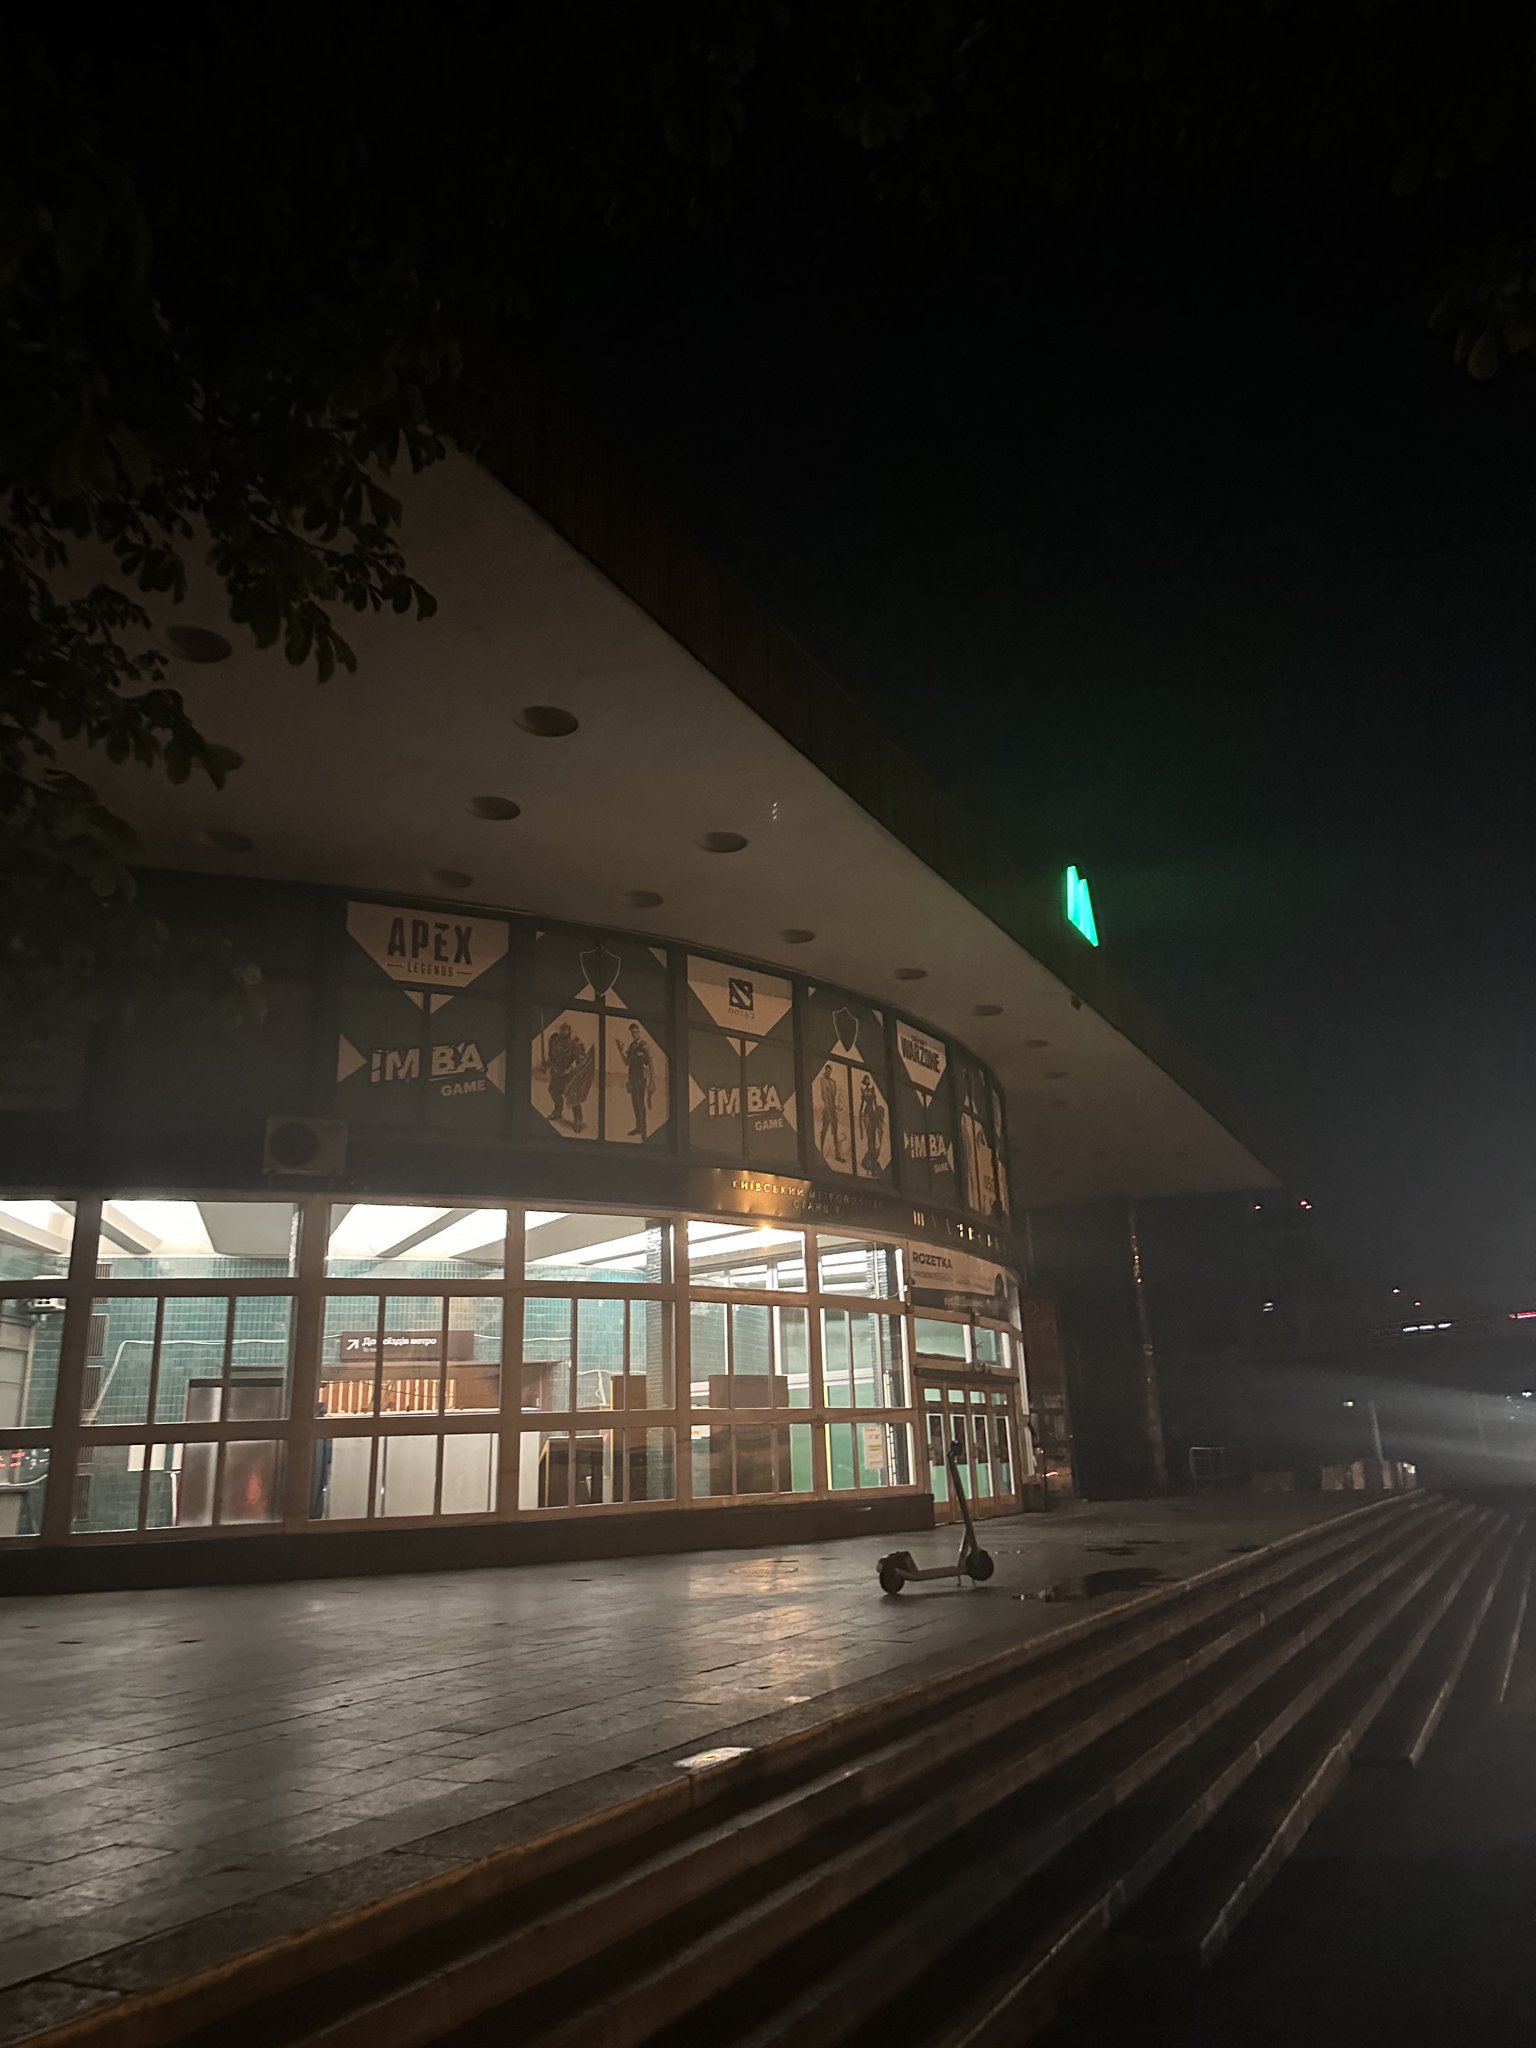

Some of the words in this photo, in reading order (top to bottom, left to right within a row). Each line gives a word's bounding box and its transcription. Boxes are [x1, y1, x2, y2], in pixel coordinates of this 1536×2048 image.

[387, 917, 473, 966] APEX
[406, 960, 454, 978] LEGENDS
[901, 1036, 941, 1074] WARZONE
[441, 1079, 486, 1097] GAME
[755, 1118, 784, 1131] GAME
[912, 1251, 952, 1269] ROZETKA
[362, 1336, 377, 1346] До
[382, 1336, 409, 1346] оїздів
[410, 1338, 437, 1346] метро
